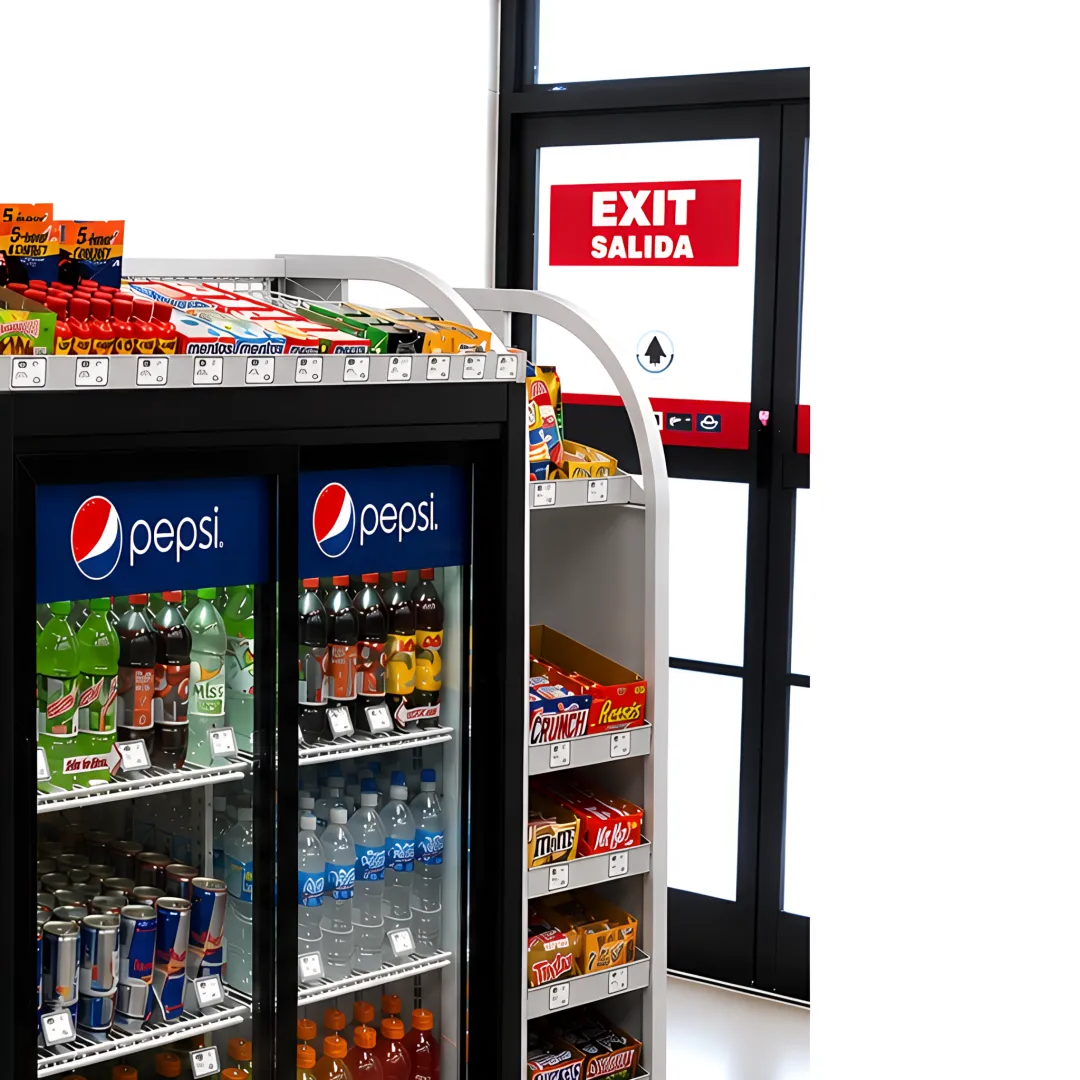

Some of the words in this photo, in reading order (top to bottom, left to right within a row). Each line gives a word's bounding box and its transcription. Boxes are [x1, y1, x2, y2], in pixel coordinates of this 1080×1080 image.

[592, 189, 696, 227] EXIT
[591, 235, 694, 259] SALIDA
[130, 506, 220, 566] pepsi
[360, 492, 436, 546] pepsi
